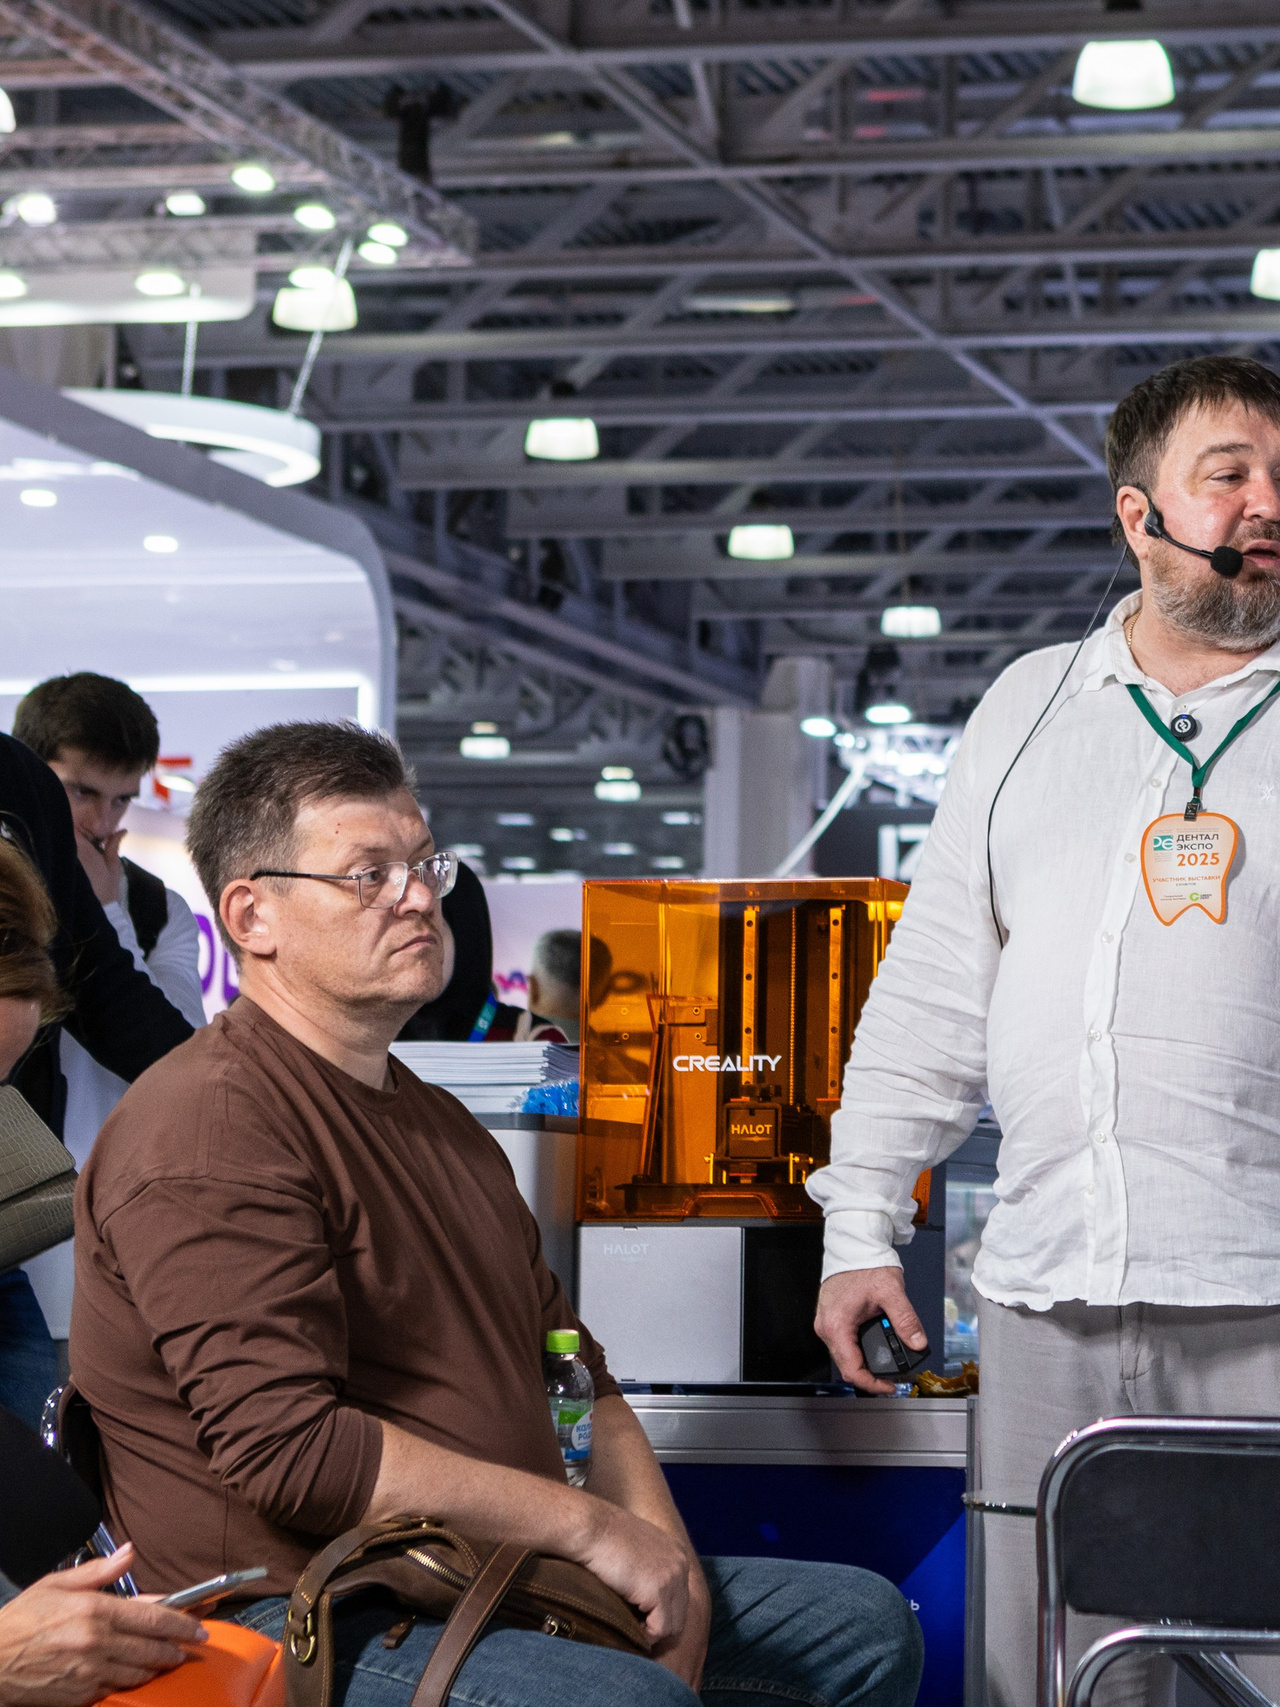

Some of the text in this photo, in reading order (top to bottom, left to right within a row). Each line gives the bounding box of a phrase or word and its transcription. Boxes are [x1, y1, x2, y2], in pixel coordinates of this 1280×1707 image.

[1176, 834, 1219, 843] ДЕНТАЛ
[1176, 843, 1214, 851] ЭКСПО
[1177, 853, 1220, 867] 2025
[672, 1054, 782, 1072] CREALITY
[730, 1124, 773, 1135] HALOT
[603, 1243, 650, 1255] HALOT
